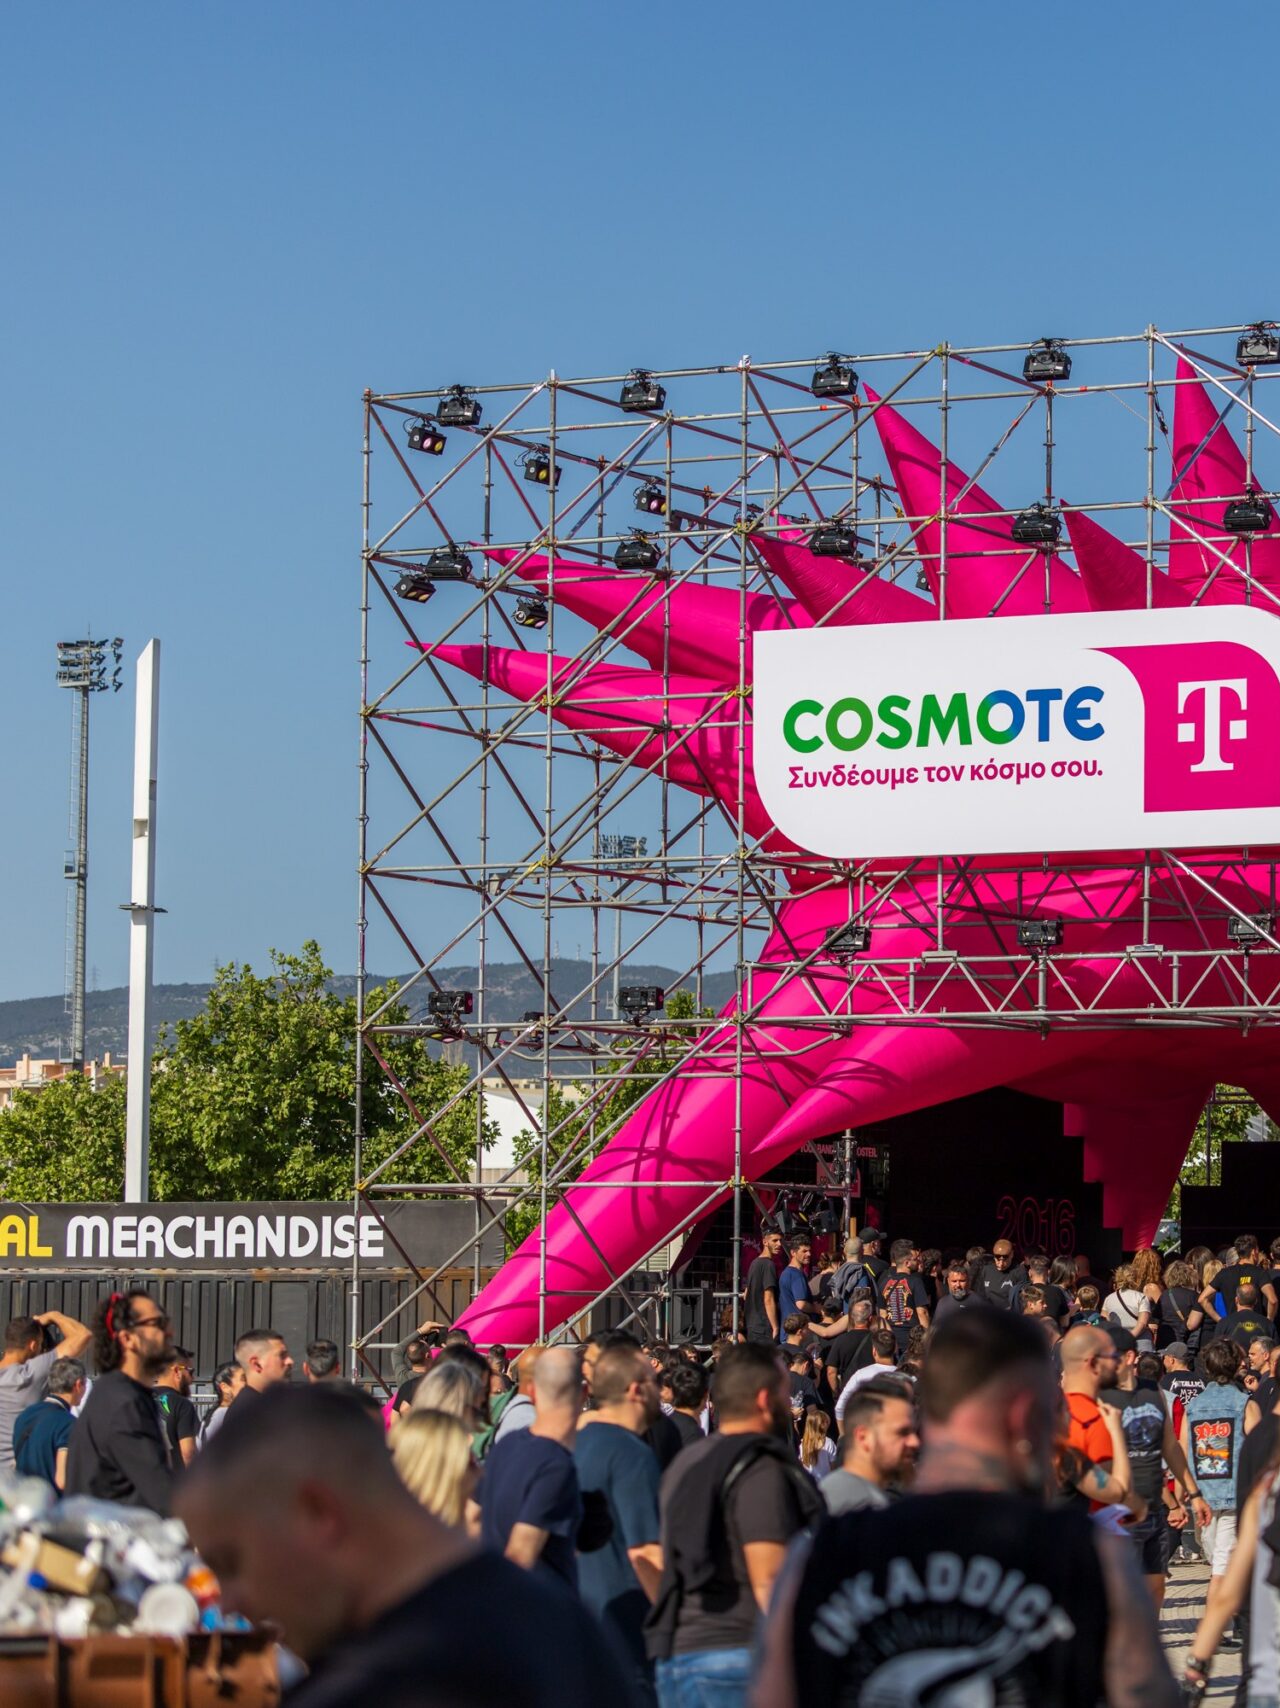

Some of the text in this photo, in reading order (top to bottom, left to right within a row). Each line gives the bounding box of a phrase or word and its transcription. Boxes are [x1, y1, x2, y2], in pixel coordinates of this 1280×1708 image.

[782, 685, 1105, 754] COSMOTE
[1177, 677, 1248, 773] T
[787, 757, 1103, 790] Συνδέουμε τον κόσμο σου.
[66, 1215, 384, 1258] MERCHANDISE
[997, 1195, 1076, 1256] 2016
